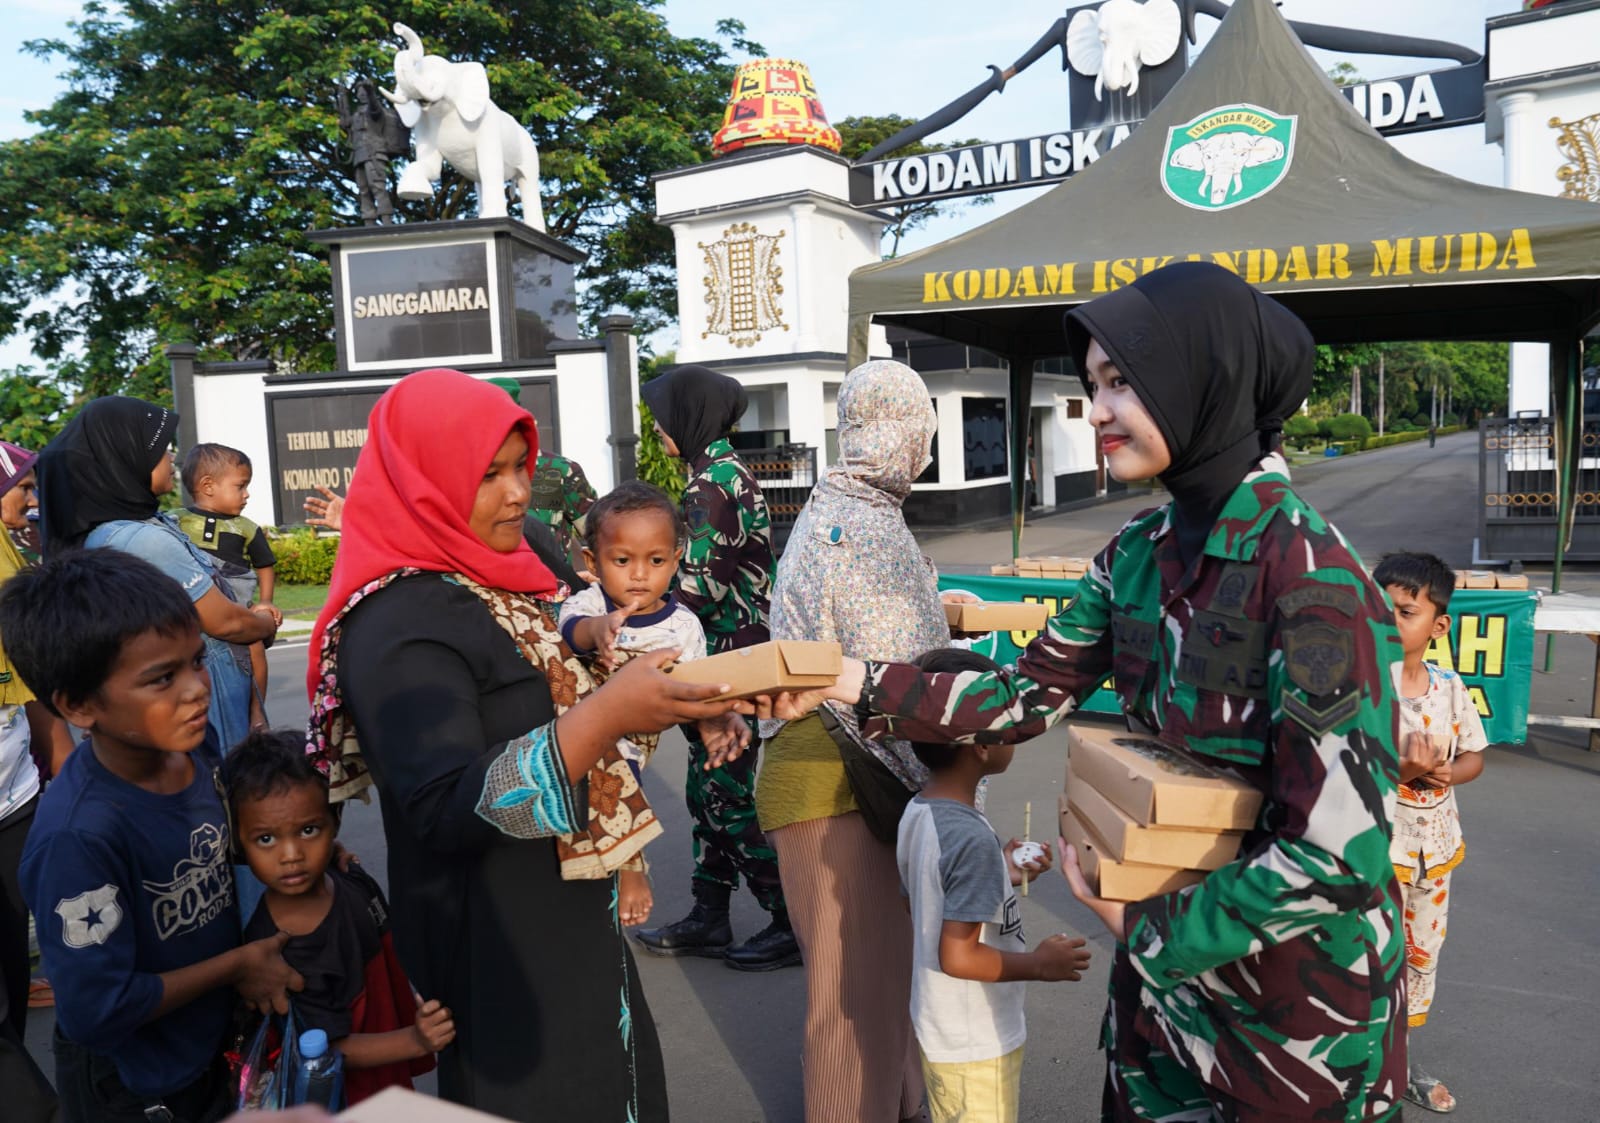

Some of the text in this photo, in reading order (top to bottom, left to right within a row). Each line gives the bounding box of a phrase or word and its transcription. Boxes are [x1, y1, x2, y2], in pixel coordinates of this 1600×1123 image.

[1191, 113, 1271, 136] ISKANDAR MUDA
[873, 142, 1017, 200] KODAM
[922, 228, 1537, 303] KODAM ISNDAR MUDA
[353, 287, 489, 318] SANGGAMARA
[286, 431, 330, 451] TENTARA
[283, 467, 340, 490] KOMANDO
